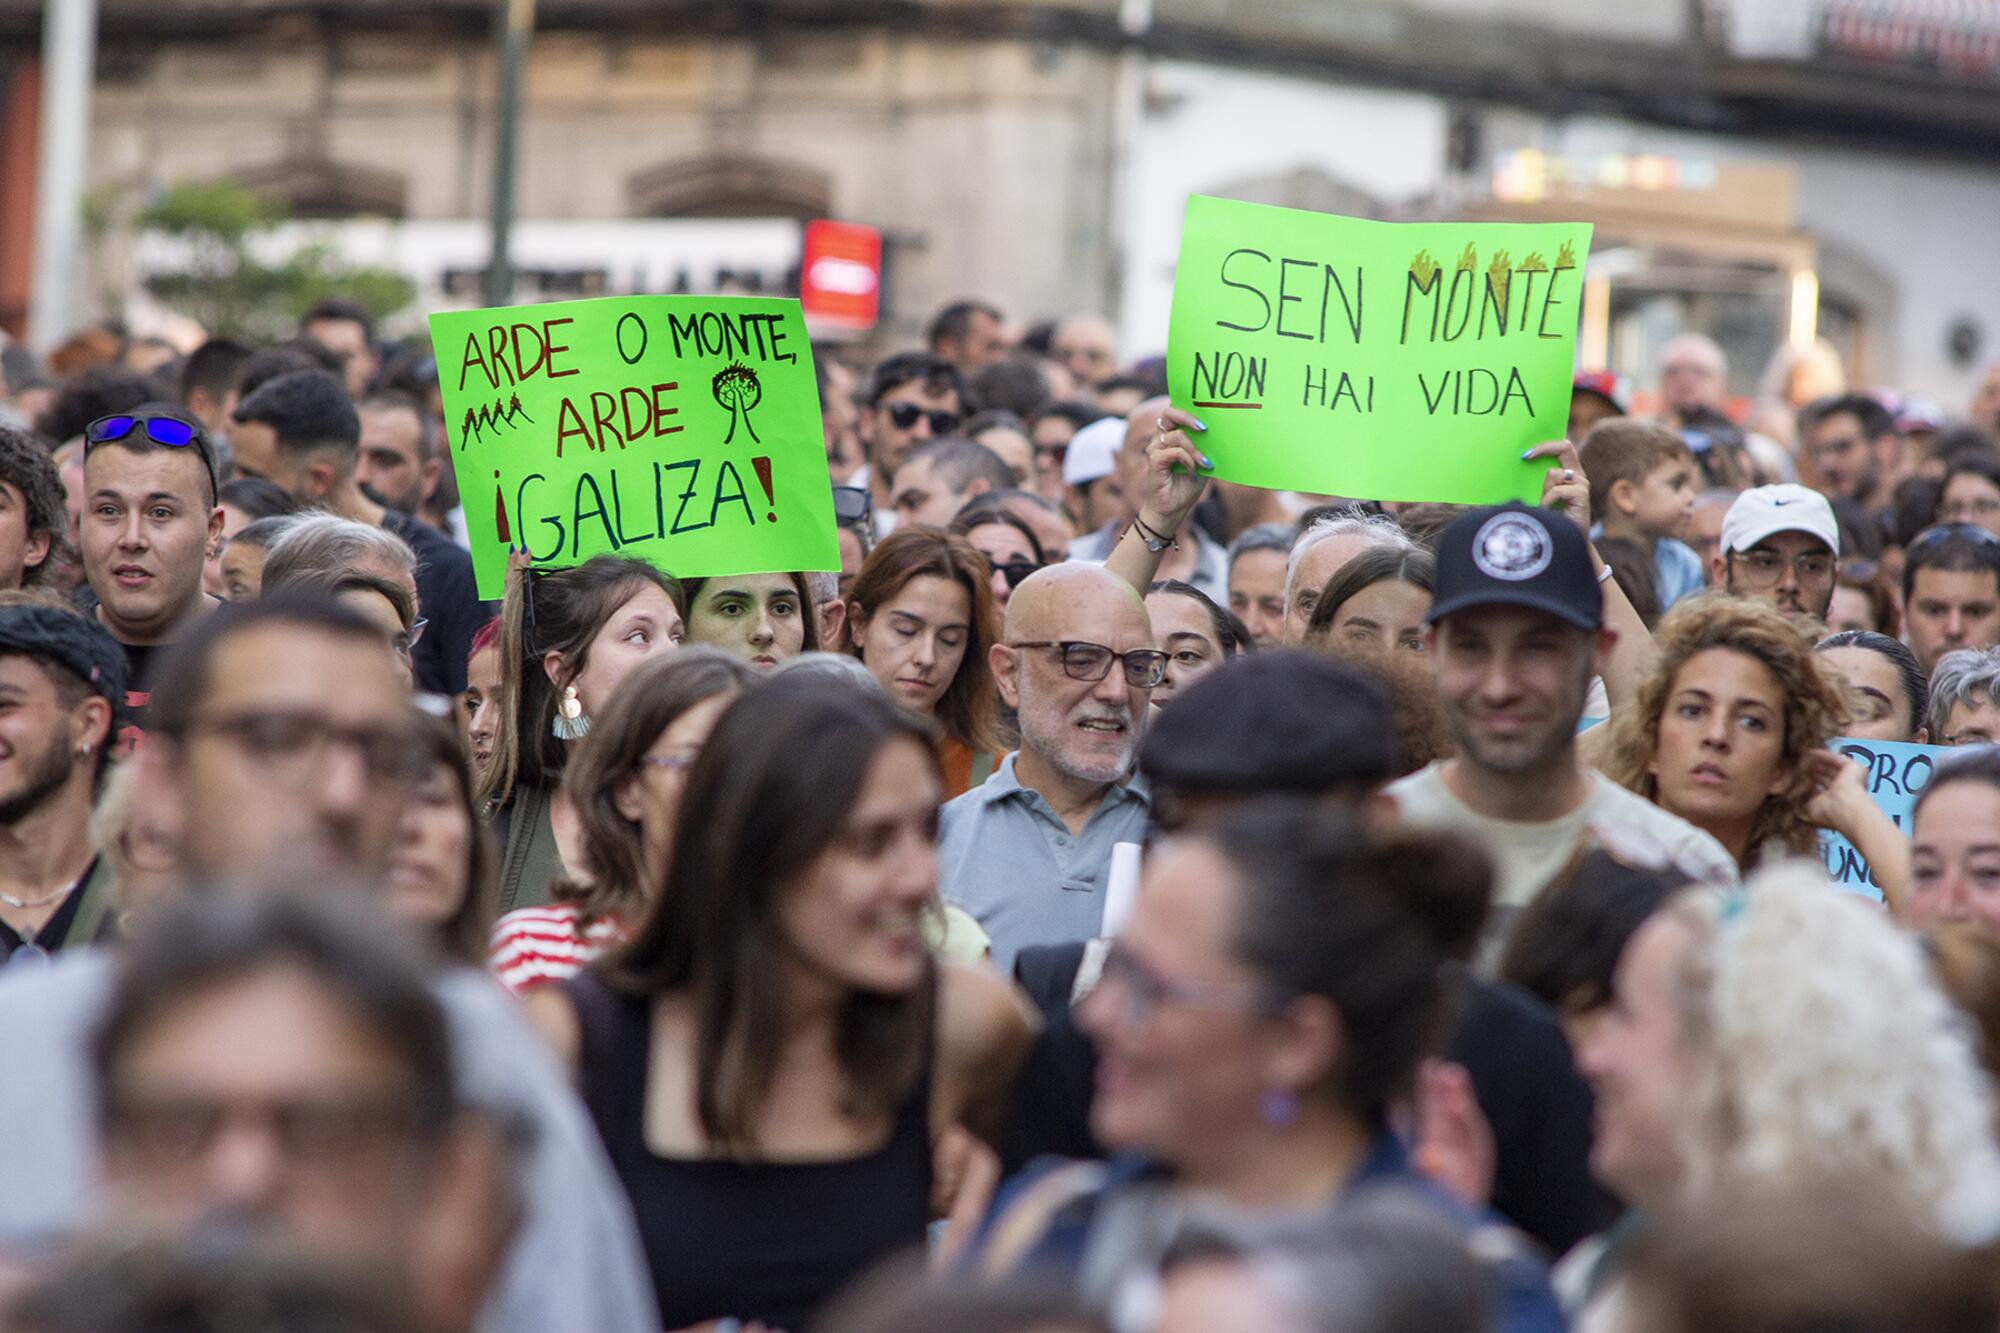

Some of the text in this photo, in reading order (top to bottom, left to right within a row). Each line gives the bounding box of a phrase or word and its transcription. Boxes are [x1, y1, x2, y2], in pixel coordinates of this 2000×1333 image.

[1215, 249, 1577, 345] SEN MONTE
[460, 312, 797, 391] ARDE O MONTE,
[1192, 351, 1536, 418] NON HAI VIDA
[556, 381, 684, 458] ARDE
